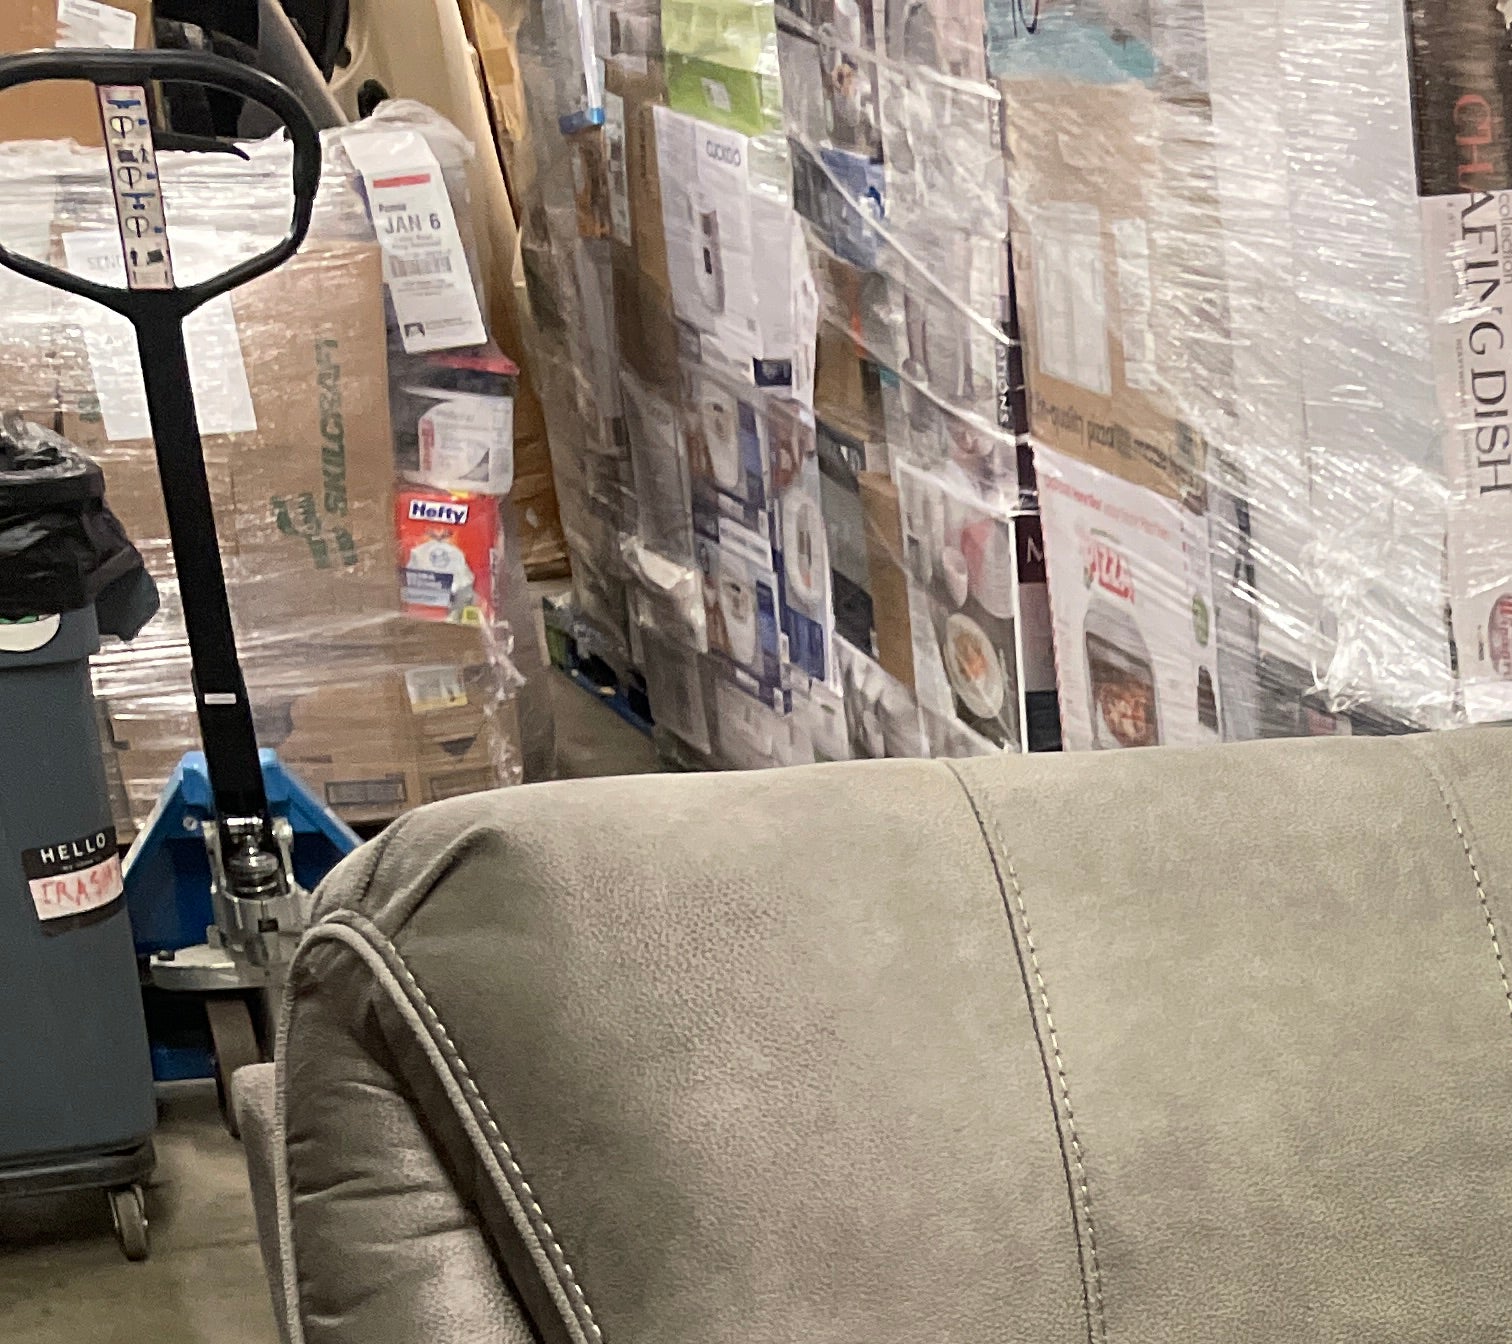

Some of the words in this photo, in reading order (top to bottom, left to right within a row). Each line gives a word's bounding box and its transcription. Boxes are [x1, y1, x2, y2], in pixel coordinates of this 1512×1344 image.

[385, 213, 422, 234] JAN
[429, 213, 442, 230] 6
[1453, 94, 1505, 356] CHAFING
[412, 502, 465, 524] Hefty
[39, 832, 106, 865] HELLO
